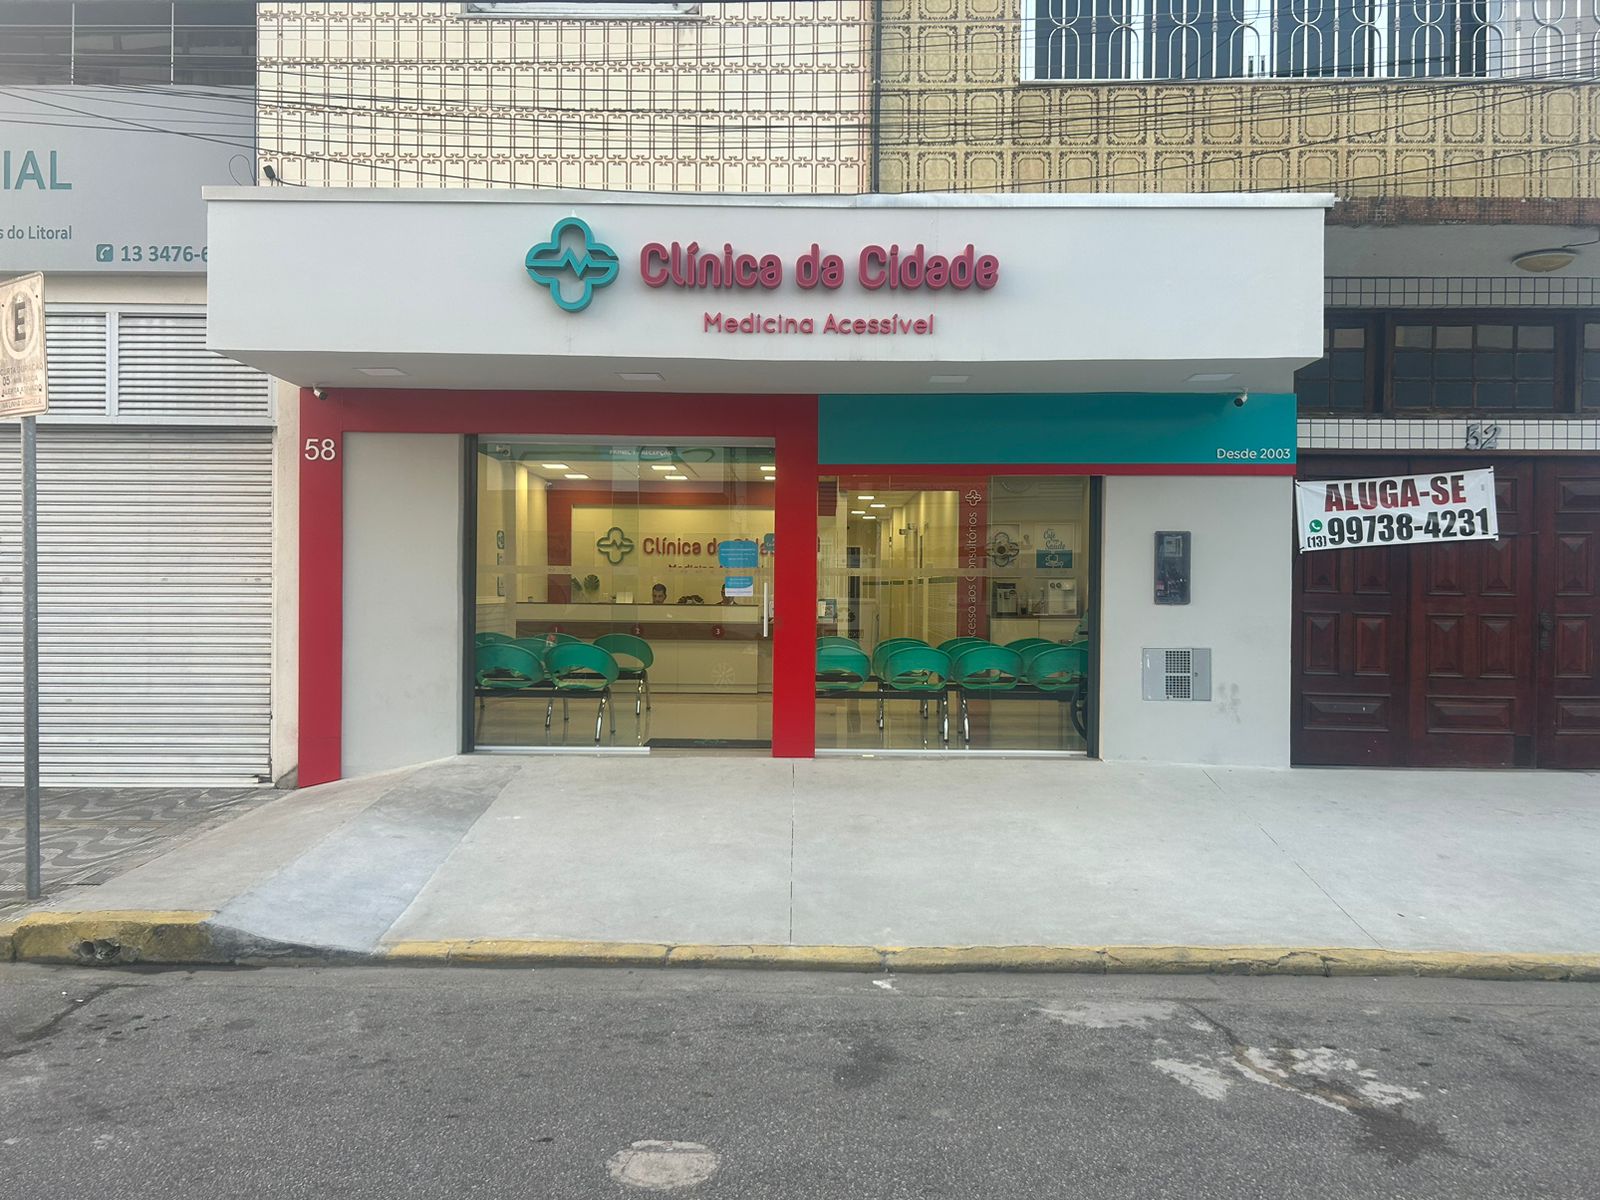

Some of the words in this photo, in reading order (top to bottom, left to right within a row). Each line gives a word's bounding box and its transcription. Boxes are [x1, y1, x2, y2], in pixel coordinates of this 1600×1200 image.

[7, 225, 24, 239] do
[28, 225, 72, 239] Litoral
[120, 246, 142, 262] 13
[640, 240, 783, 288] Clínica
[795, 242, 845, 289] da
[858, 243, 999, 290] Cidade
[15, 301, 26, 341] E
[703, 312, 814, 334] Medicina
[823, 312, 935, 335] Acessível
[1465, 423, 1501, 449] 52
[304, 438, 336, 461] 58
[1216, 447, 1257, 459] Desde
[1260, 447, 1290, 459] 2003
[1324, 475, 1467, 512] ALUGA-SE
[1307, 535, 1327, 548] (13)
[1327, 508, 1488, 546] 99738-4231
[643, 537, 700, 556] Clínica
[707, 537, 720, 556] d
[968, 584, 977, 603] aos
[715, 627, 720, 635] 3
[968, 605, 977, 638] cesso
